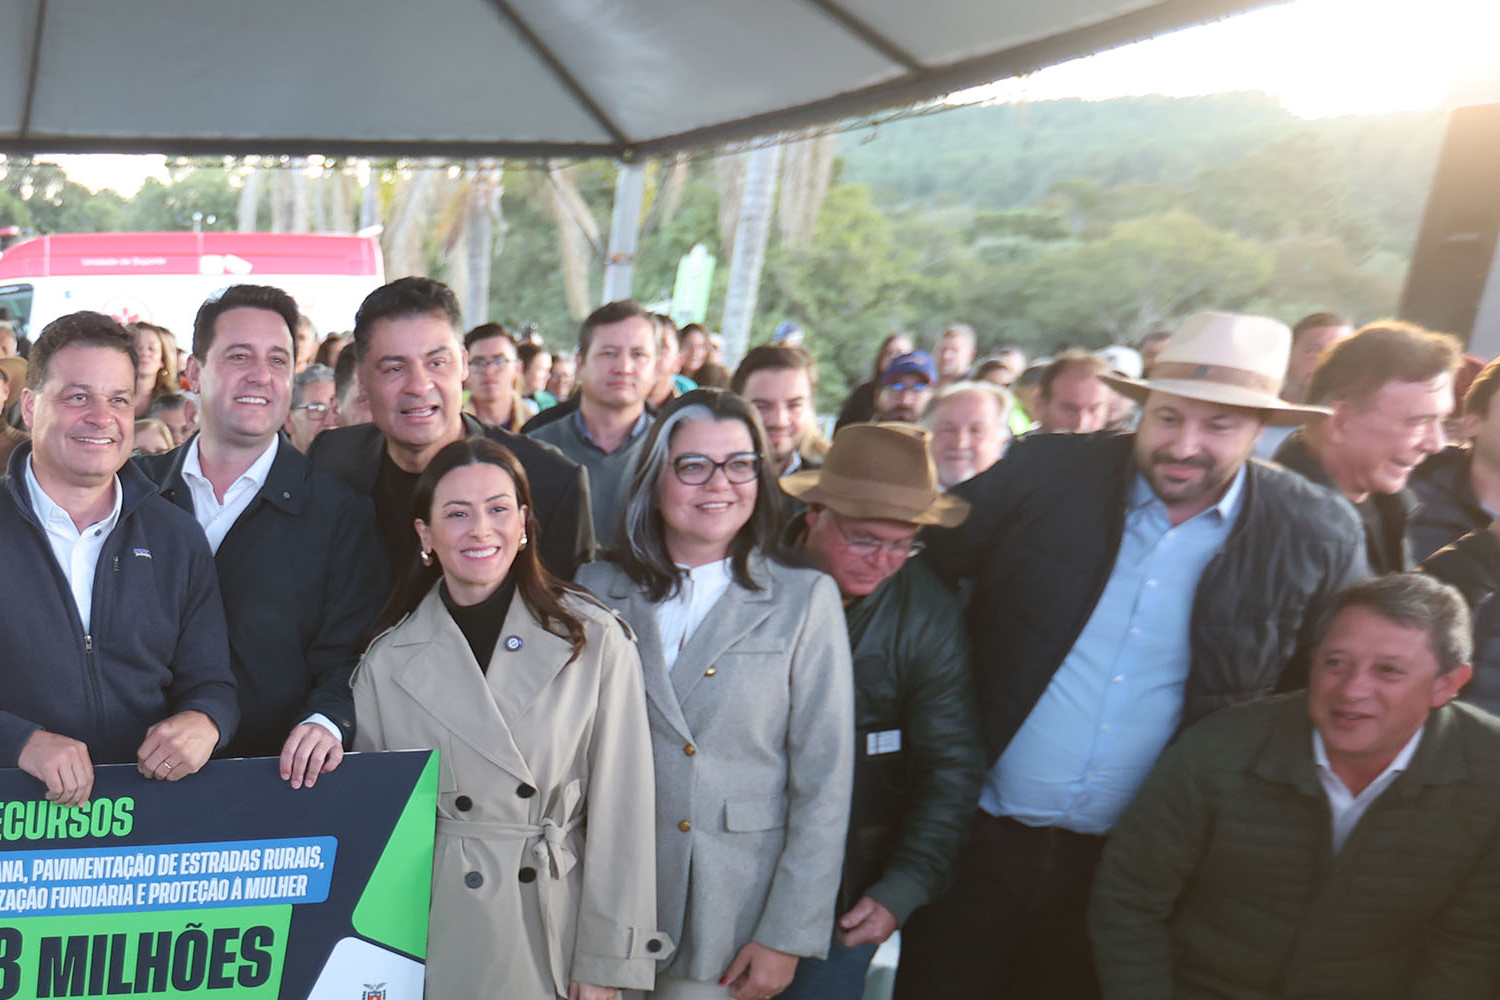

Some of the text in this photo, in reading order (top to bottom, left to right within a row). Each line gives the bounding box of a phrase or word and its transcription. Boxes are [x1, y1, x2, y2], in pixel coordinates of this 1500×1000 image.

[32, 853, 154, 882] PAVIMENTAÇÃO
[157, 853, 179, 875] DE
[180, 849, 260, 874] ESTRADAS
[262, 845, 325, 871] RURAIS,
[50, 882, 134, 909] FUNDIÁRIA
[136, 883, 147, 904] E
[148, 877, 229, 906] PROTEÇÃO
[231, 875, 243, 900] À
[244, 874, 309, 900] MULHER
[36, 922, 276, 998] MILHÕES
